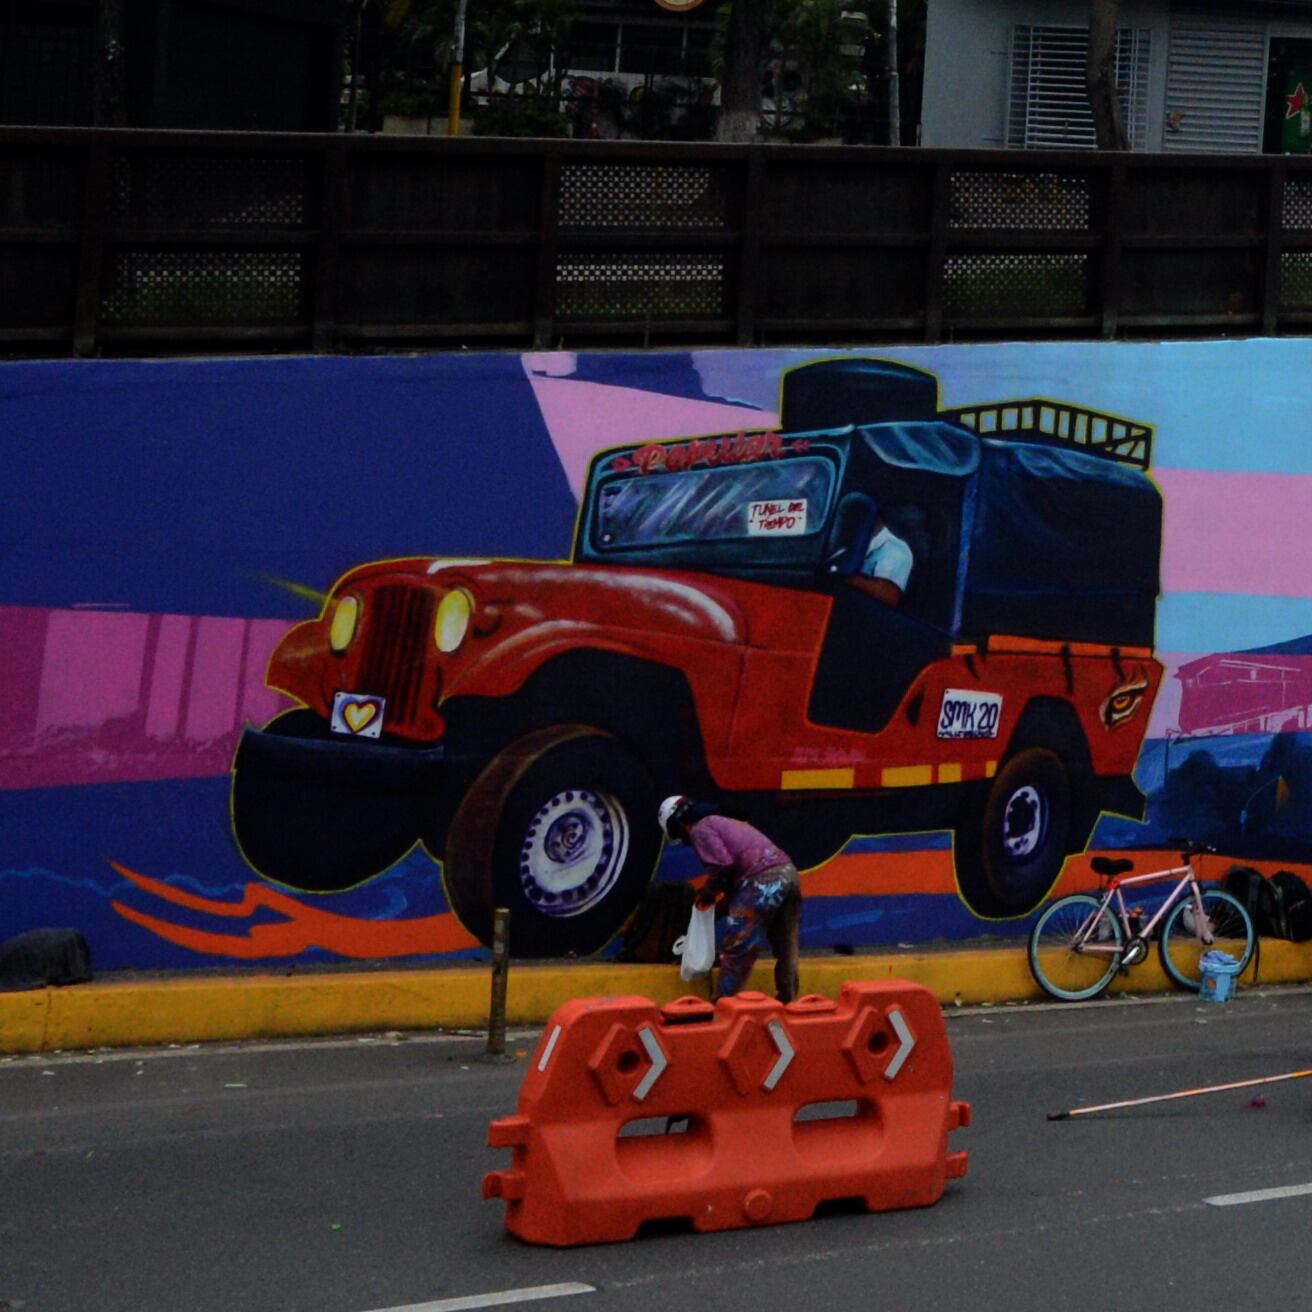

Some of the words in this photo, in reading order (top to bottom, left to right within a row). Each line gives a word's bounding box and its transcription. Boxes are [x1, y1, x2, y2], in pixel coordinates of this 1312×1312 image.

[632, 431, 785, 475] Popular
[752, 503, 784, 517] TUNEL
[759, 516, 796, 530] TIEMPO
[940, 700, 977, 730] SMK
[977, 701, 998, 730] 20
